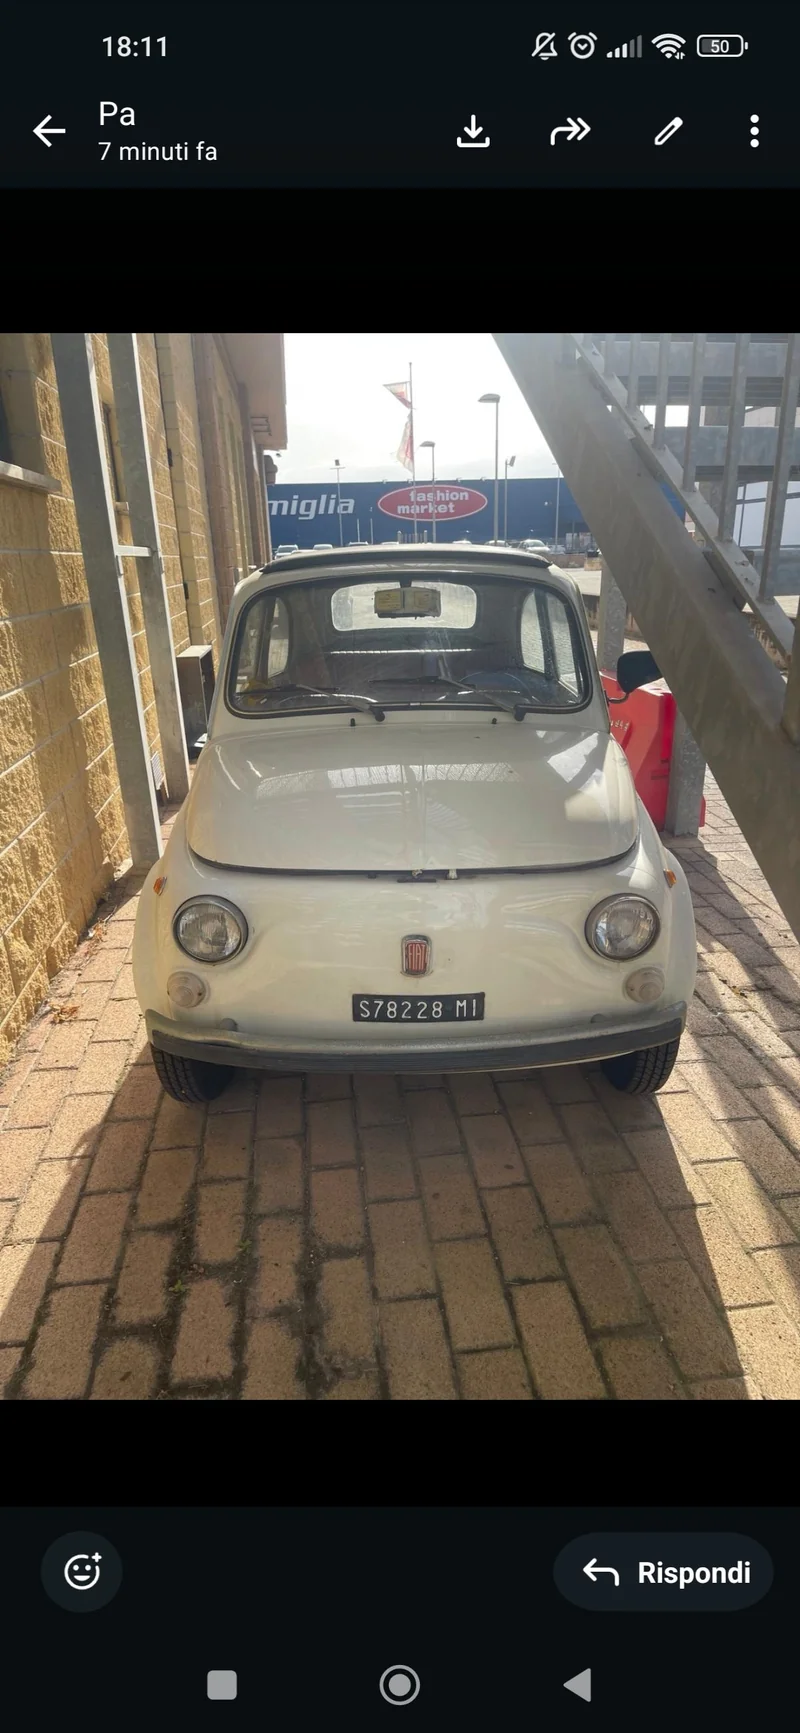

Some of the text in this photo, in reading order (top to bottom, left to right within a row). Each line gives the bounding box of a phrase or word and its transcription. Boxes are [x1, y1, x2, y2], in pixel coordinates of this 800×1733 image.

[409, 489, 469, 502] fashion
[267, 494, 355, 520] miglia
[397, 502, 455, 514] market
[408, 943, 426, 971] FIAT
[359, 999, 476, 1019] S78228 MI
